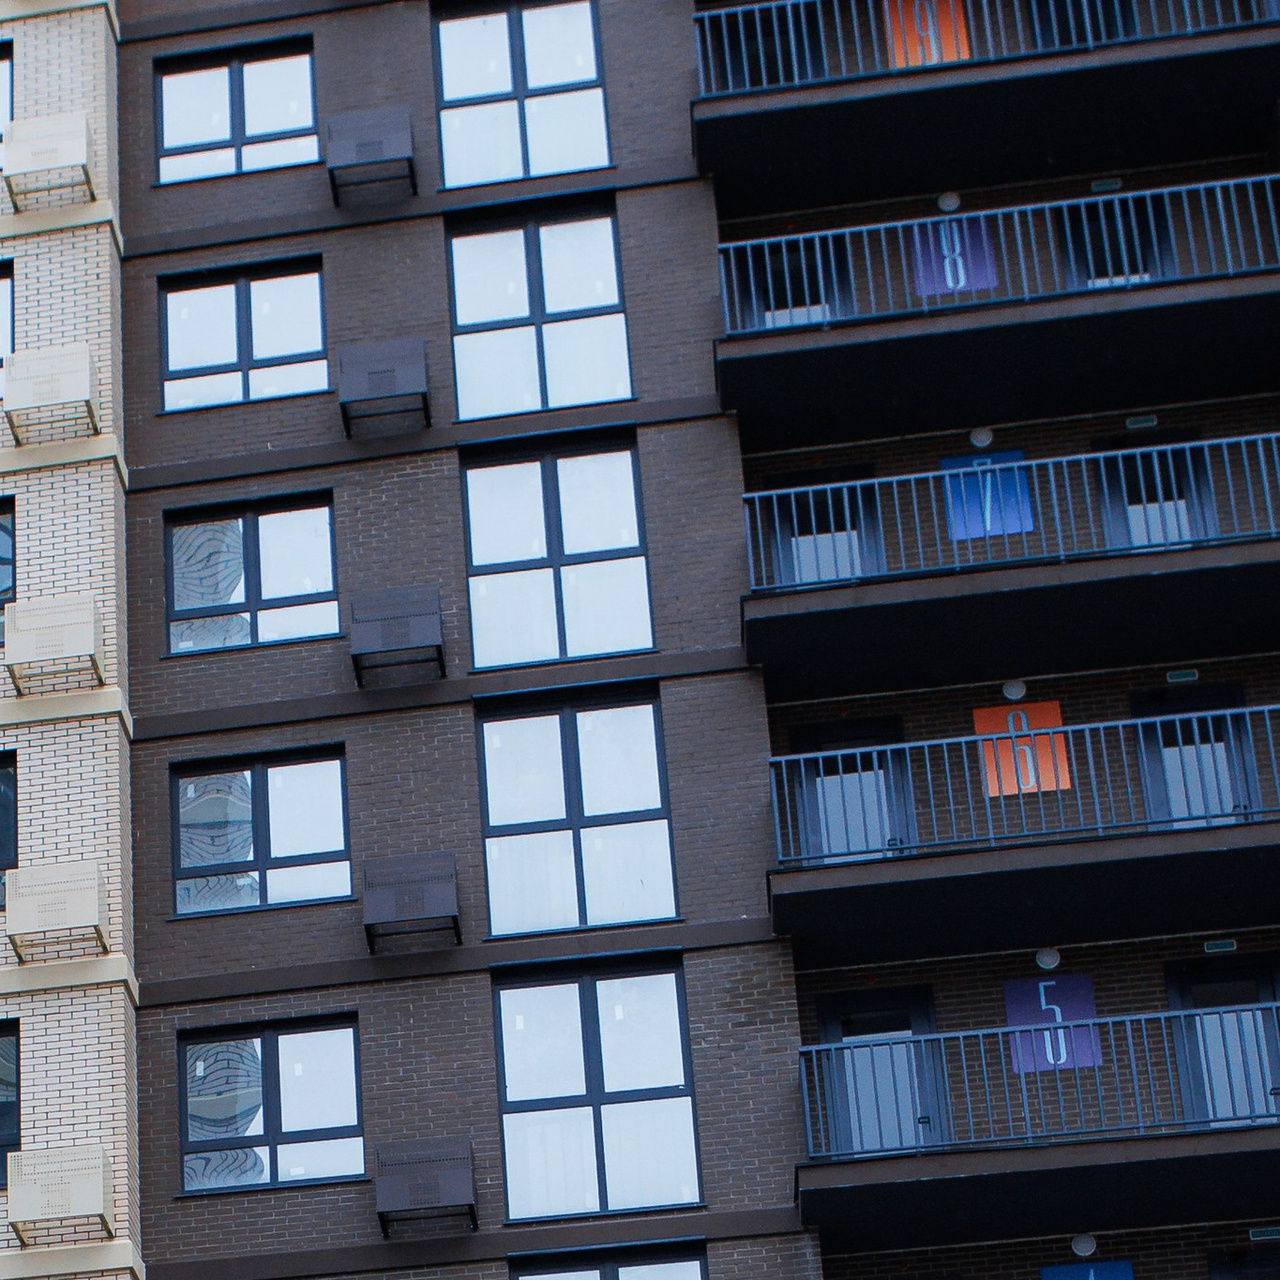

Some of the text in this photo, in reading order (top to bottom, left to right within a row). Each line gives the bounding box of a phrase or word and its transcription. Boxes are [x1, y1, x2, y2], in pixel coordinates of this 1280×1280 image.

[913, 0, 939, 66] 9
[939, 219, 966, 290] 8
[972, 458, 992, 532] 7
[1006, 710, 1037, 790] 6
[1038, 981, 1067, 1065] 5
